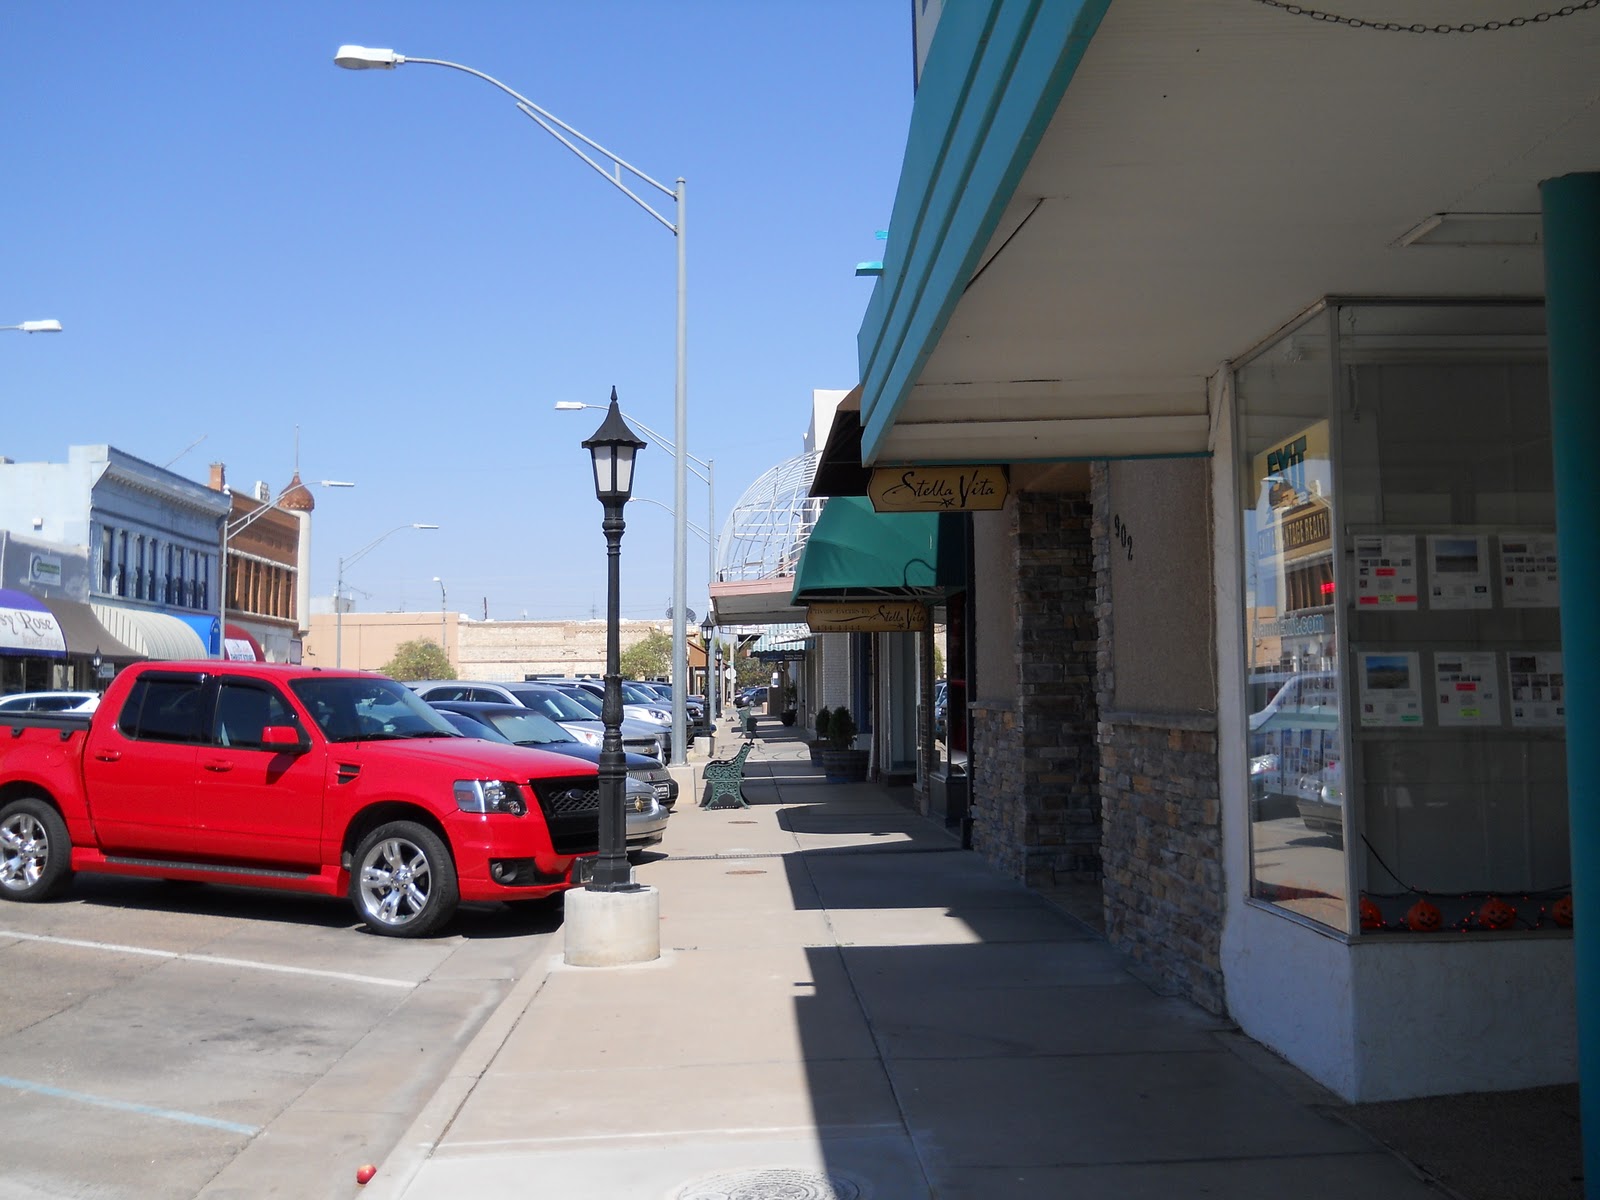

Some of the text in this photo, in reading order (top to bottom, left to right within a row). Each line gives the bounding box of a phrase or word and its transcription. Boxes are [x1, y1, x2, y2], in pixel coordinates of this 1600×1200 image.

[1267, 435, 1307, 493] EXIT
[898, 469, 995, 508] Stella Vita
[1114, 513, 1133, 561] 902
[1304, 511, 1328, 542] REALTY
[14, 611, 54, 637] Rose
[877, 604, 925, 630] Stella Vita
